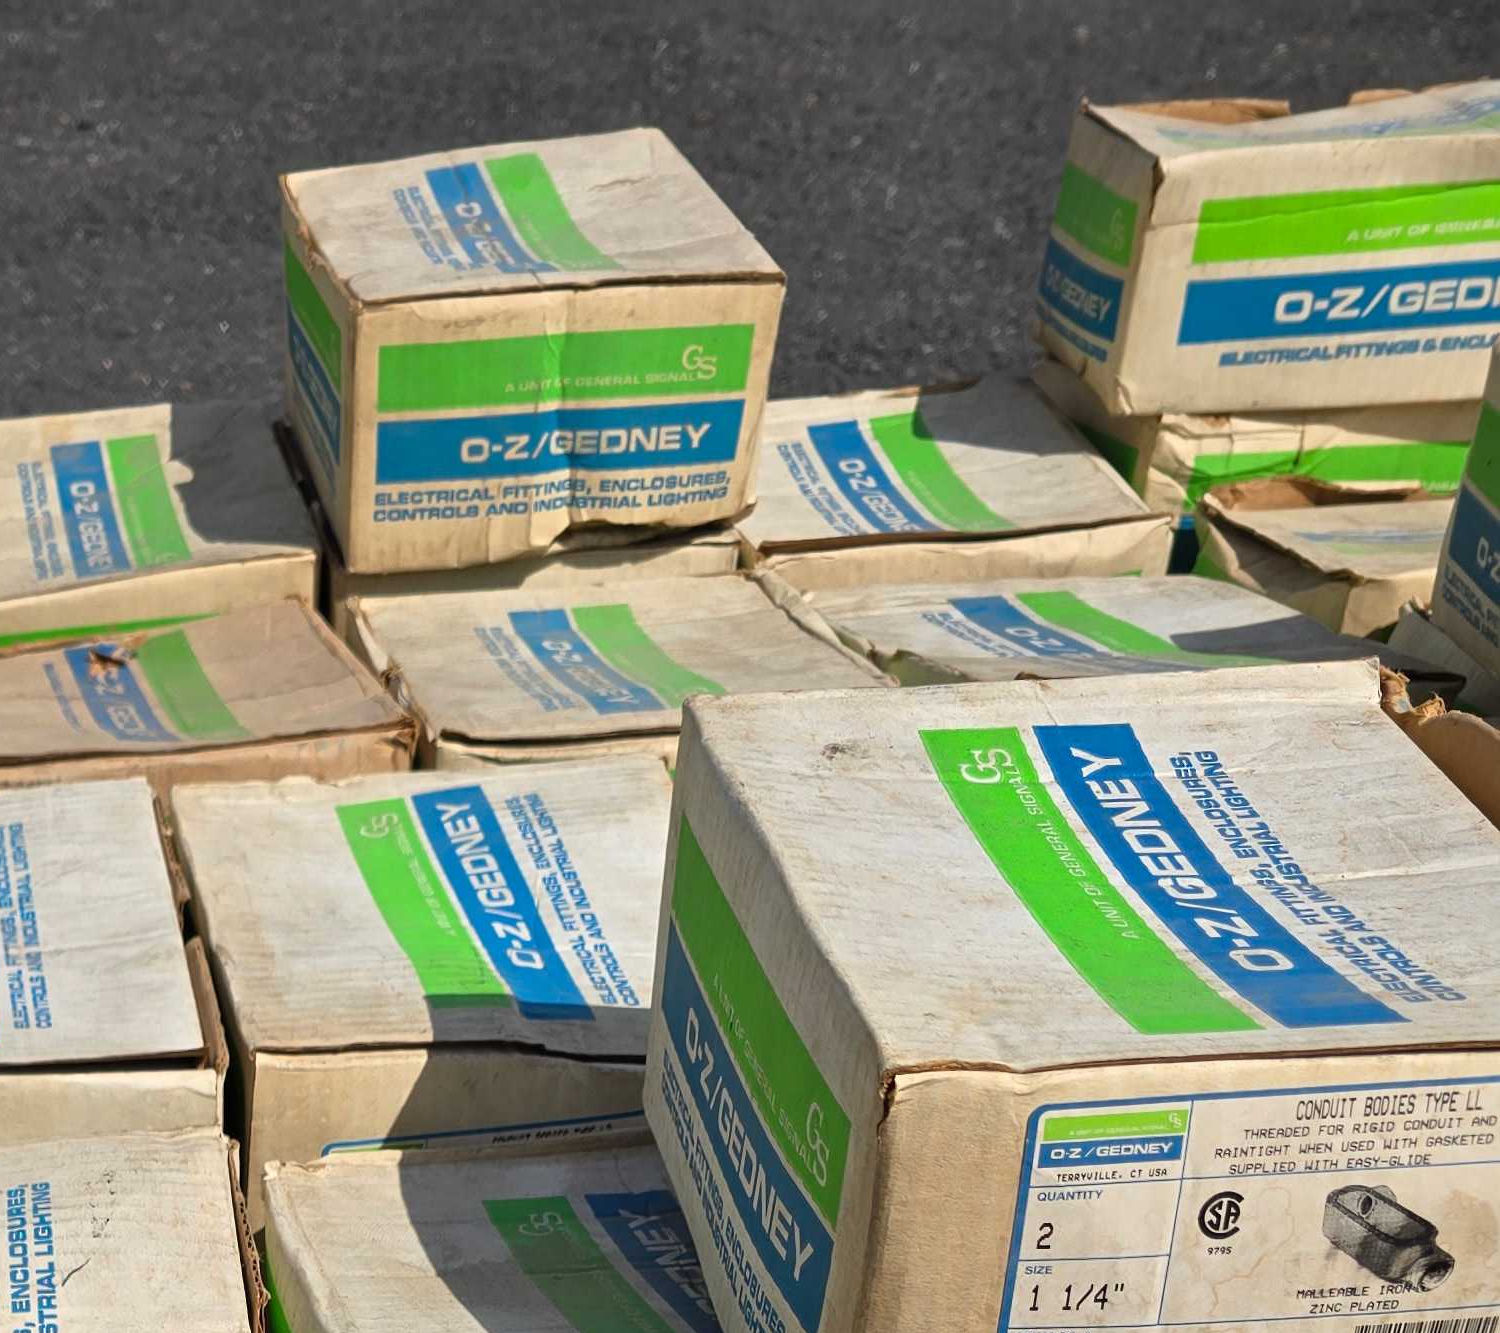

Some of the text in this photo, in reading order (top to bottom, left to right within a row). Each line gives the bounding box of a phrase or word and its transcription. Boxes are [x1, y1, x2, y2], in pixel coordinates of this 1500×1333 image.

[1274, 277, 1500, 324] O-Z/GED
[461, 423, 712, 462] O-Z/GEDNEY
[373, 506, 479, 522] CONTROLS
[485, 502, 528, 516] AND
[647, 487, 727, 506] LIGHTING
[375, 488, 494, 507] ELECTRICAL
[1170, 752, 1259, 859] ENCLOSURES,
[1037, 821, 1086, 879] GENERAL
[1070, 747, 1294, 972] O-Z/GEDNEY
[436, 802, 545, 970] O-Z/GEDNEY
[1195, 749, 1467, 1001] CONTROLS LIGHTING
[1092, 899, 1128, 929] UNIT
[1315, 927, 1434, 1004] ELECTRICAL
[1296, 1091, 1483, 1121] CONDUIT BODIES TYPE LL
[685, 1007, 814, 1281] O-Z/GEDNEY
[1243, 1127, 1310, 1139] THREADED
[1426, 1132, 1494, 1147] GASKETED
[1050, 1143, 1172, 1160] O-Z/GEDNEY
[1148, 1167, 1167, 1178] USA
[1037, 1190, 1102, 1202] QUANTITY
[32, 1182, 54, 1256] LIGHTING
[7, 1184, 32, 1313] ENCLOSURES,
[1025, 1265, 1052, 1274] SIZE
[1029, 1283, 1124, 1310] 1 1/4"
[1309, 1299, 1399, 1314] ZINC PLATED
